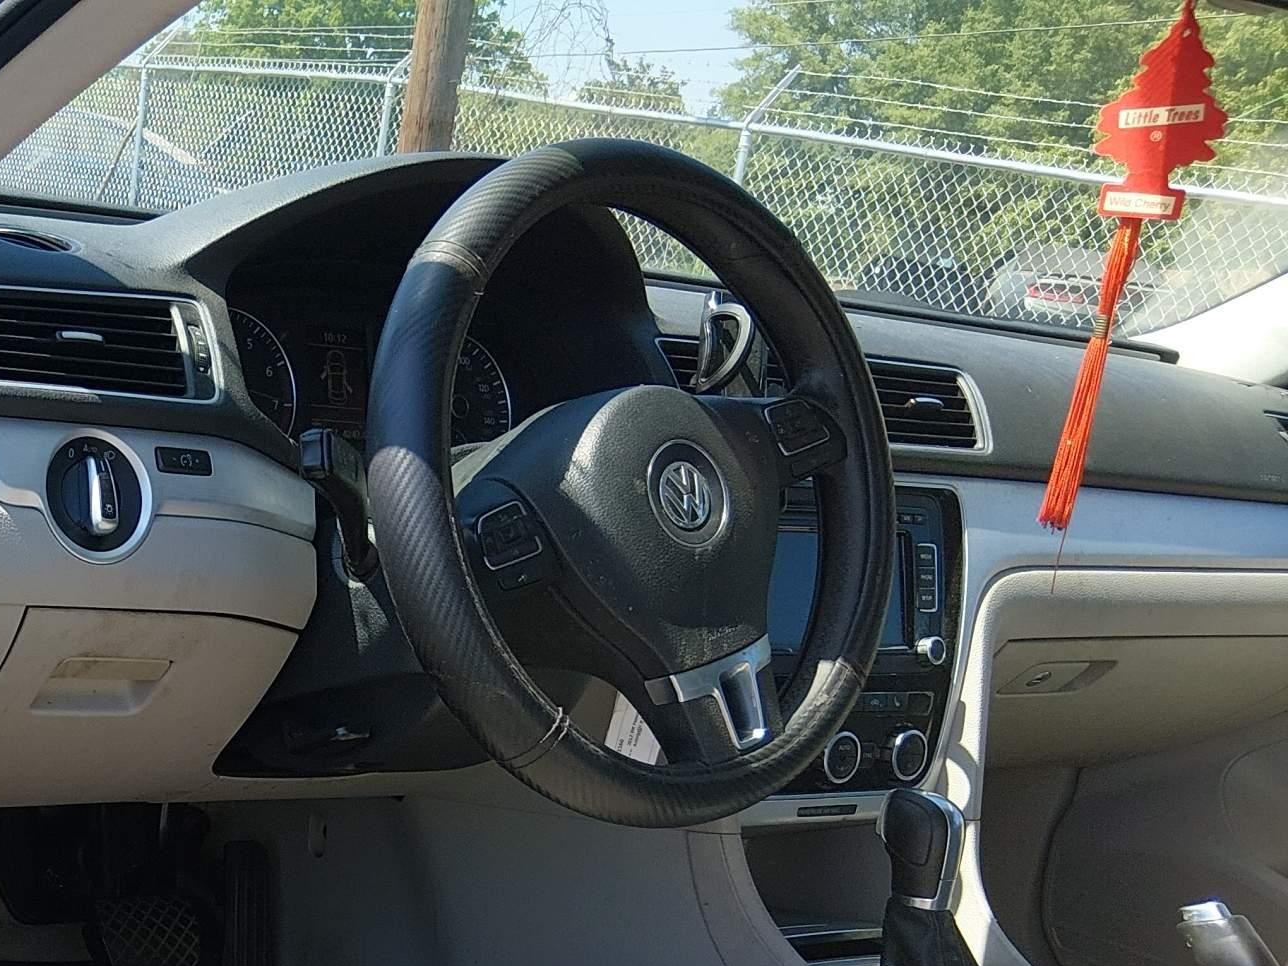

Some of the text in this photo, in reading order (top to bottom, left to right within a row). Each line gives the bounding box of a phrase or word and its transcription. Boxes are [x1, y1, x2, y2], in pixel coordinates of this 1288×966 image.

[1124, 108, 1200, 126] Little Trees
[1109, 195, 1172, 213] Wild Cherry
[246, 339, 254, 350] 5
[265, 367, 273, 378] 6
[272, 400, 279, 411] 7
